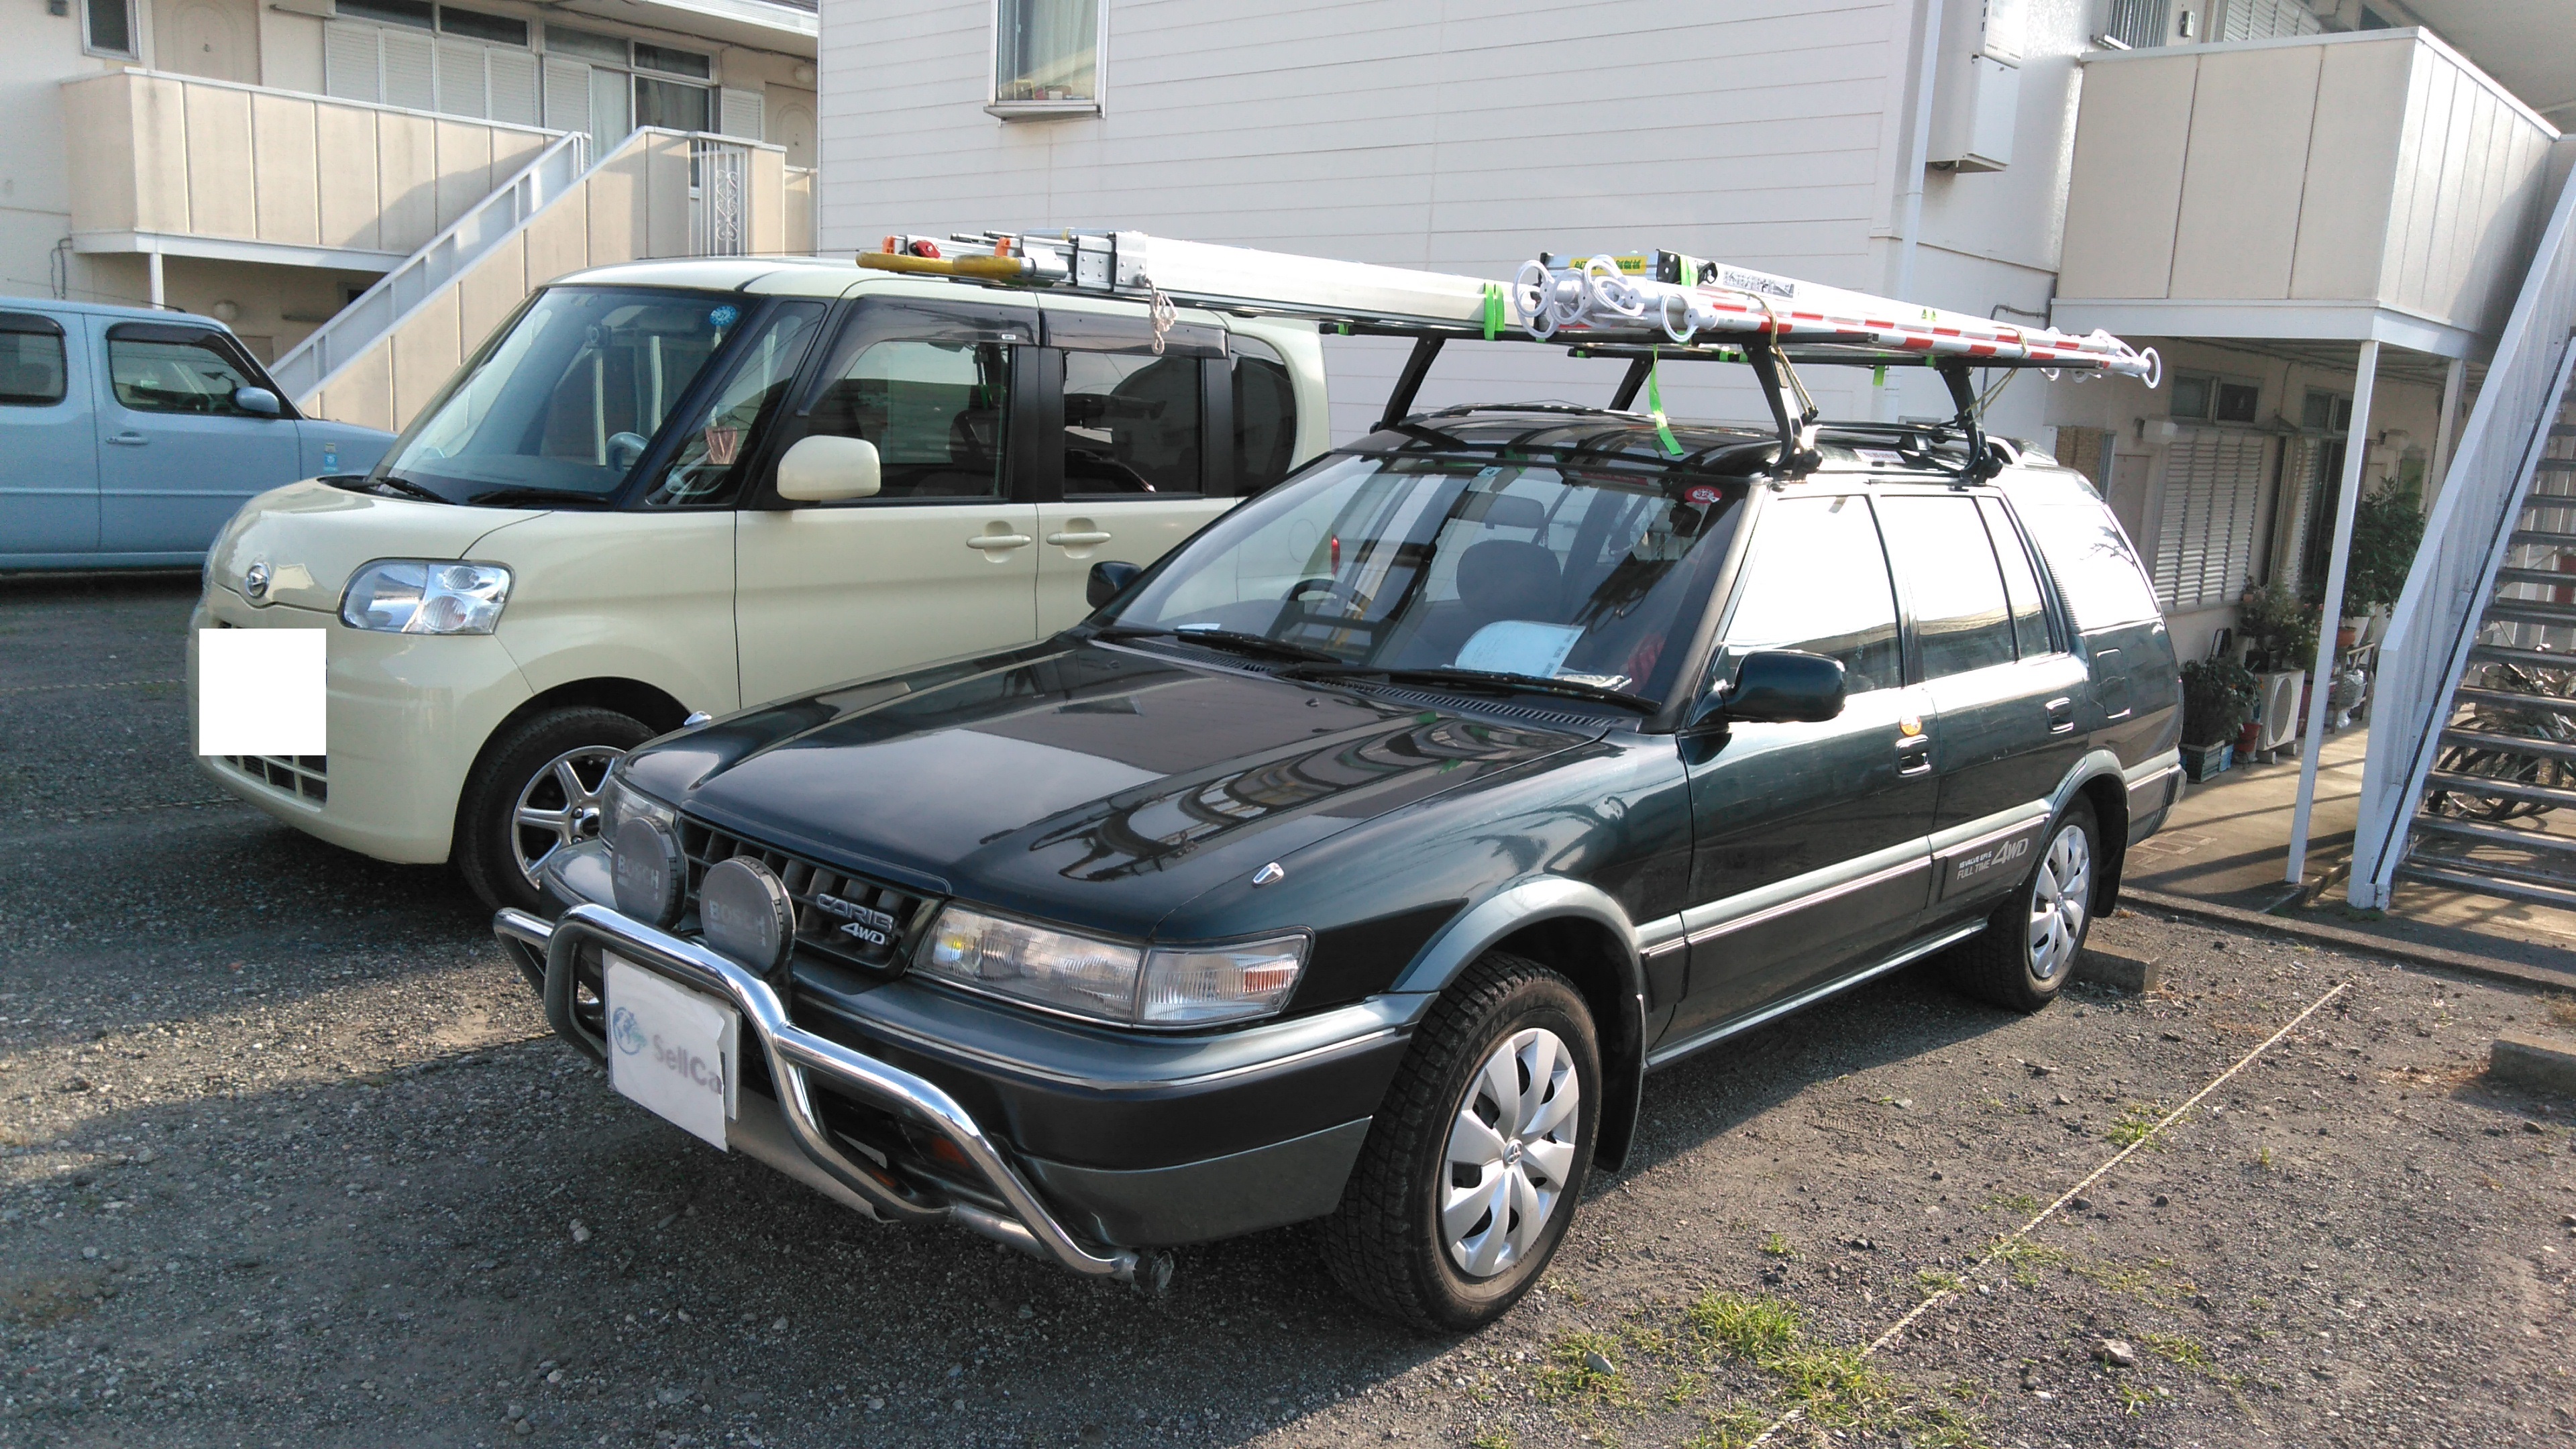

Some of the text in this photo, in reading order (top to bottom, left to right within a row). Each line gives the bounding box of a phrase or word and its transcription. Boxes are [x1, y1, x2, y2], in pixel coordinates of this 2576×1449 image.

[1990, 837, 2029, 865] 4WD
[617, 853, 659, 890] BOSCH
[1957, 859, 1990, 880] FULL TIME
[709, 900, 765, 936] BOSCH
[816, 893, 894, 932] CARIB
[841, 922, 885, 945] 4WD
